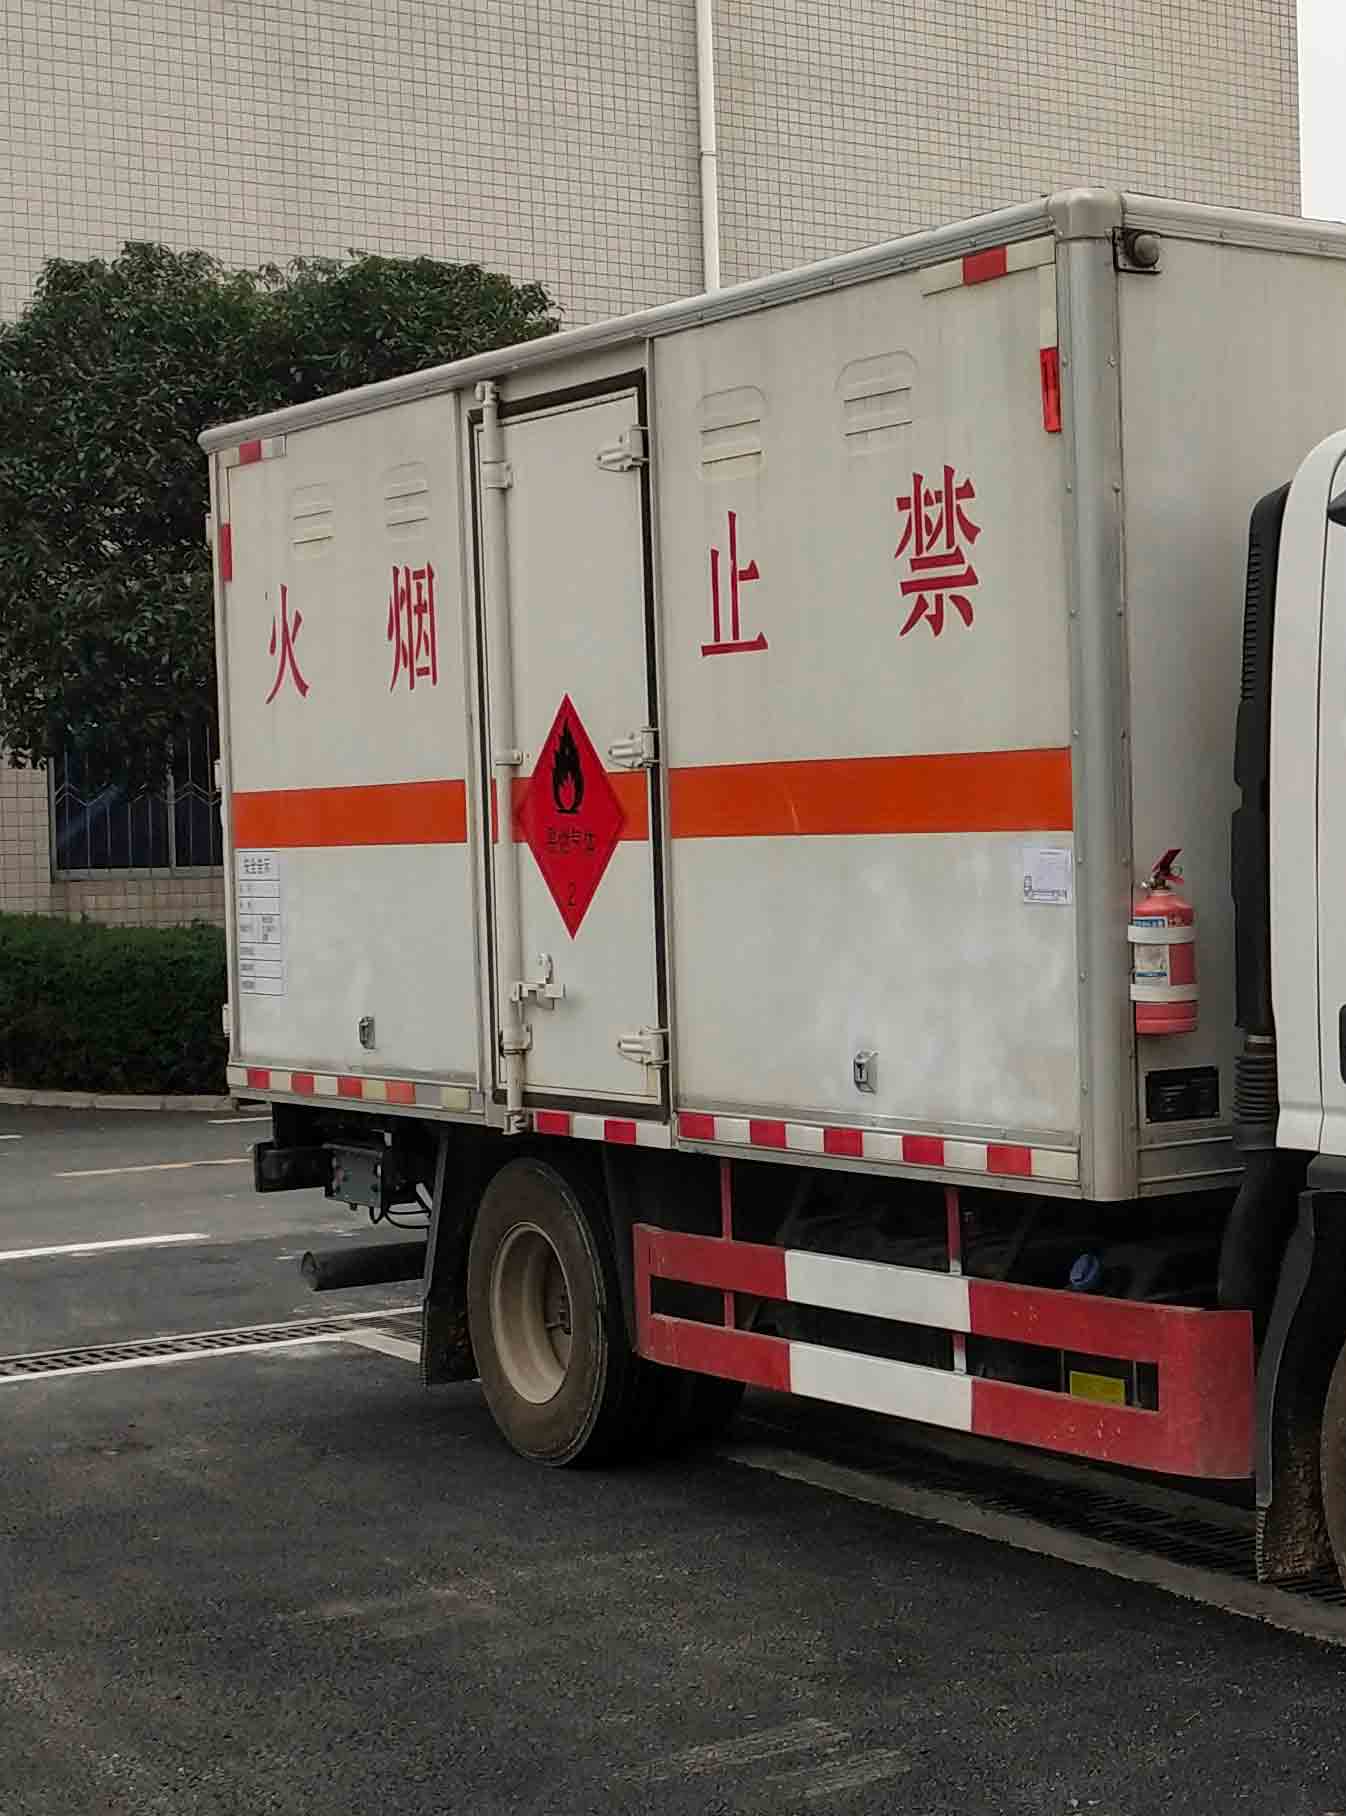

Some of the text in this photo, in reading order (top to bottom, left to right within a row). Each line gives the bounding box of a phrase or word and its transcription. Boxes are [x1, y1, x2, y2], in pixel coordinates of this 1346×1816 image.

[264, 464, 982, 706] 火 烟 止 禁
